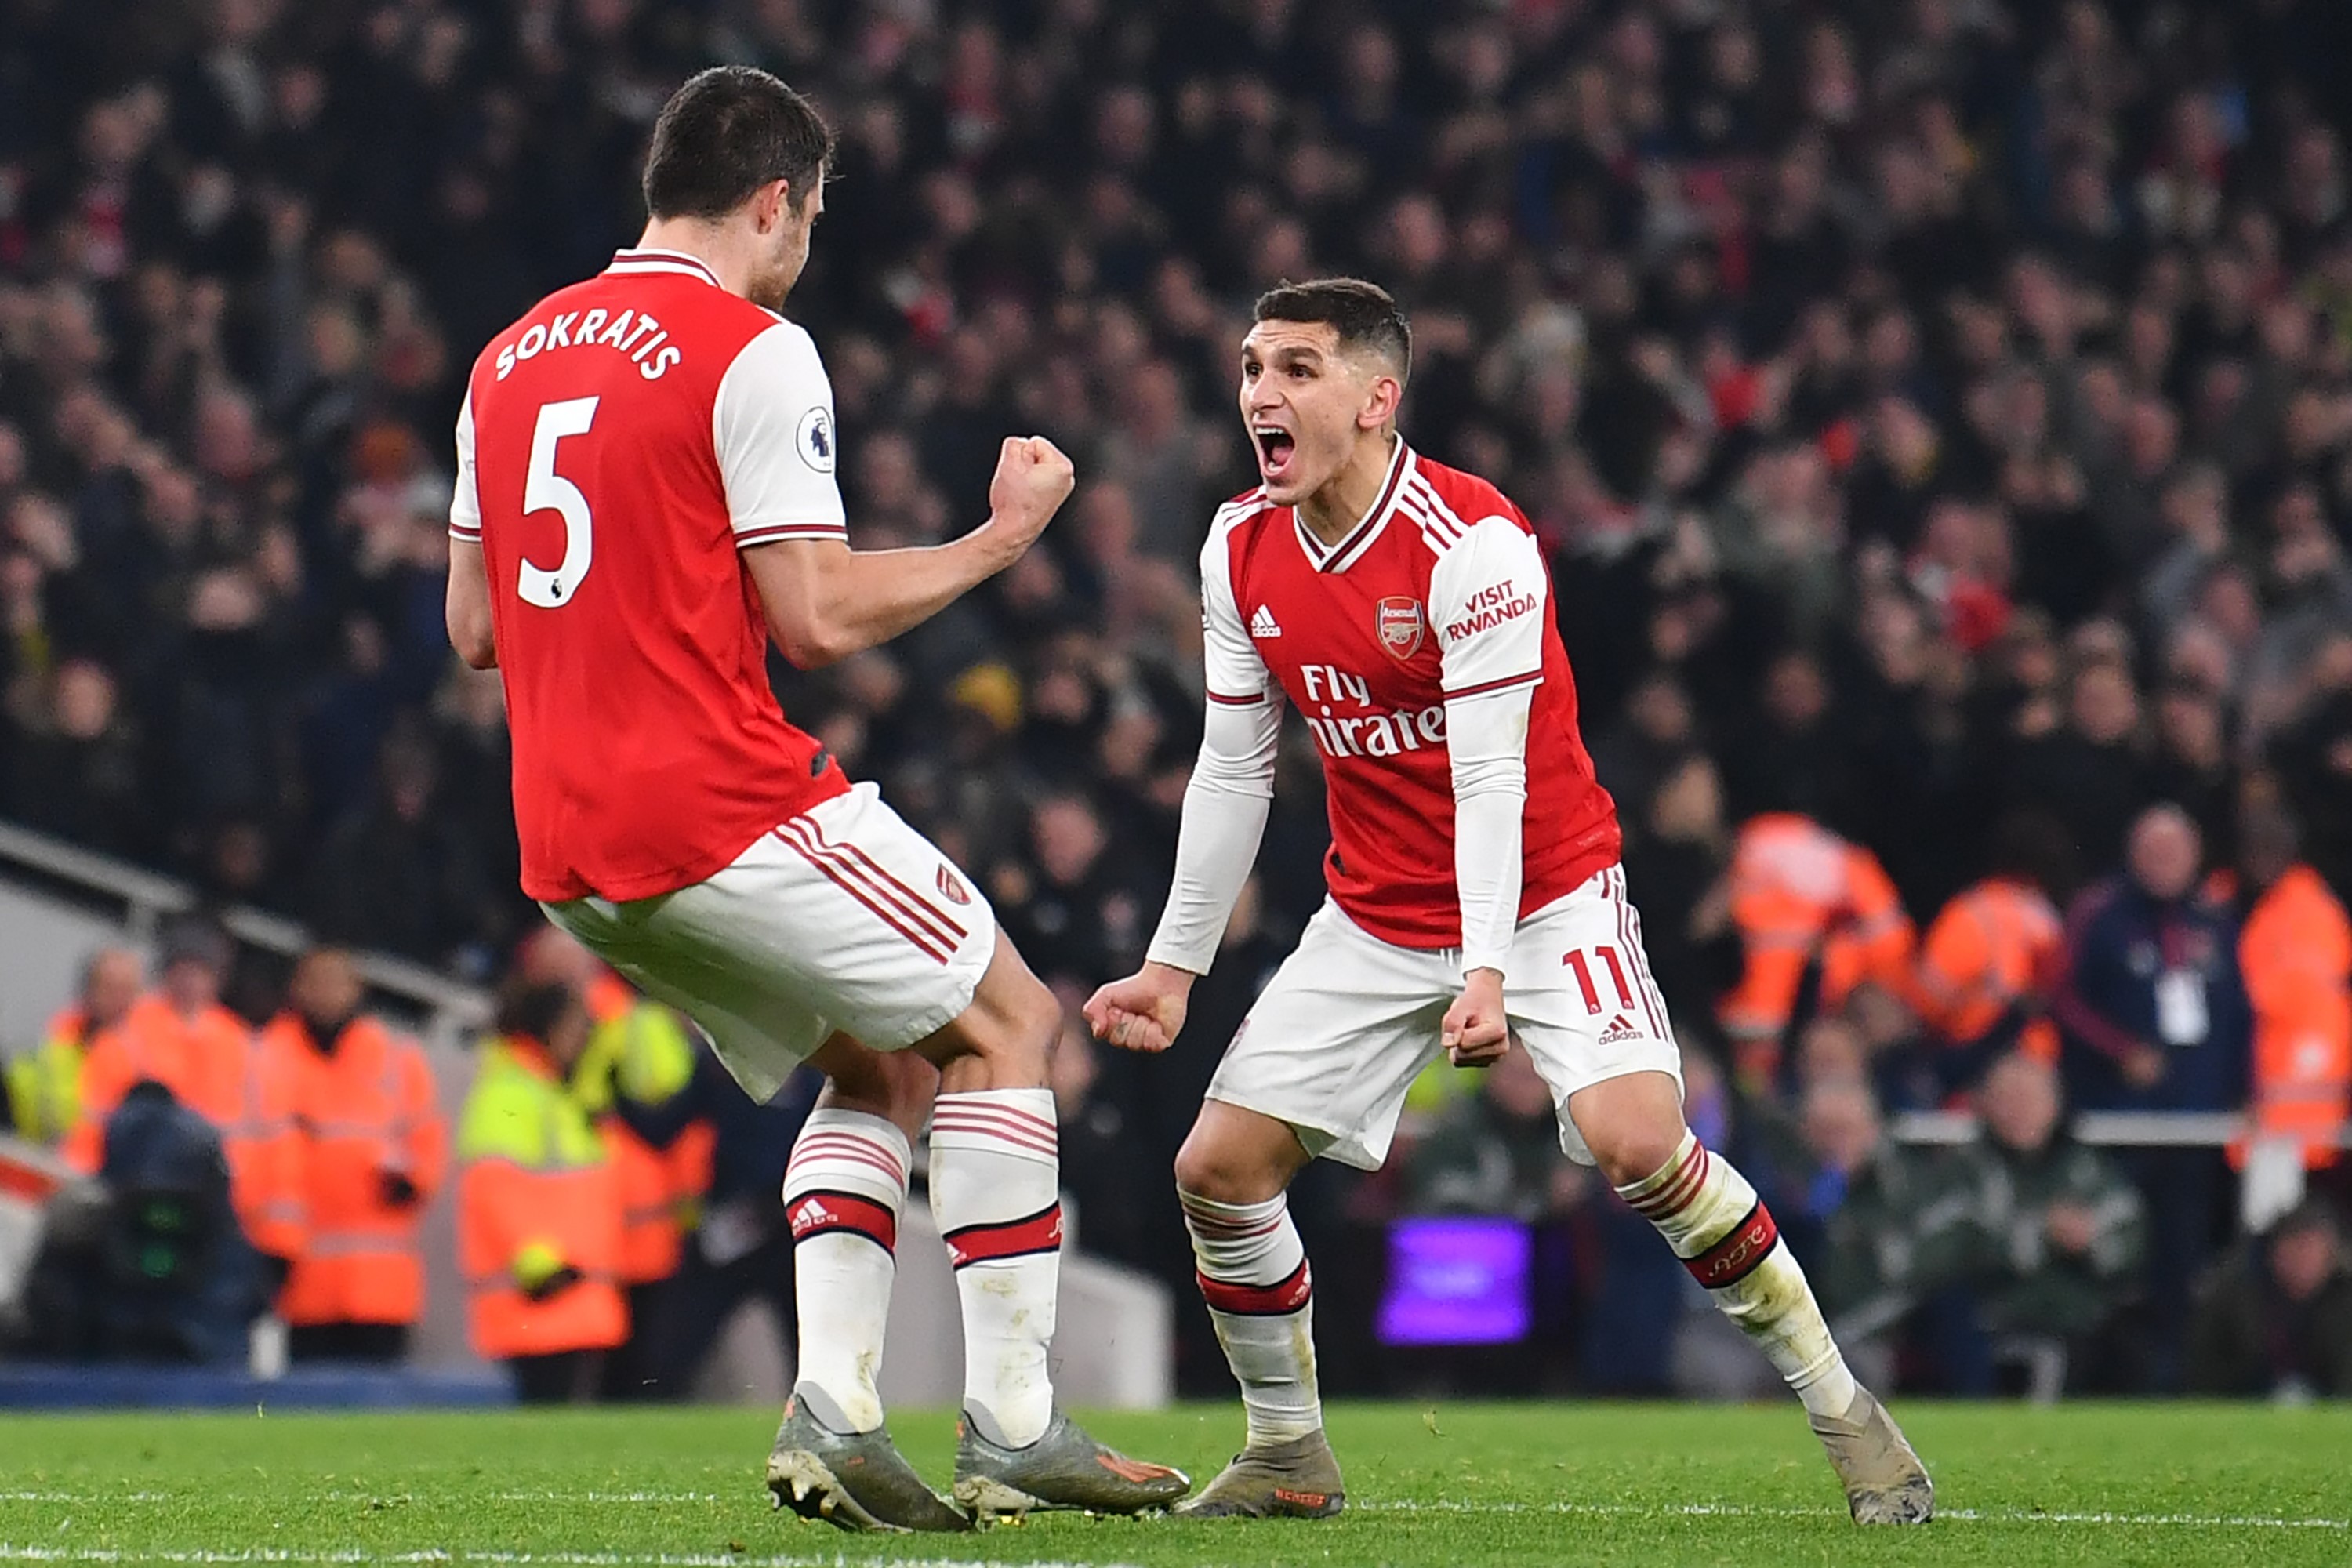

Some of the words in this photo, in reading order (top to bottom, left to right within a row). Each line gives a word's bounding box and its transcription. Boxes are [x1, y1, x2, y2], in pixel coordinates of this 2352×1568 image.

[495, 309, 681, 380] SOKRATIS
[517, 396, 601, 609] 5
[1446, 593, 1537, 641] RWANDA
[1465, 579, 1512, 613] VISIT
[1300, 665, 1370, 707] Fly
[1563, 946, 1635, 1015] 11
[1599, 1030, 1644, 1045] adidas
